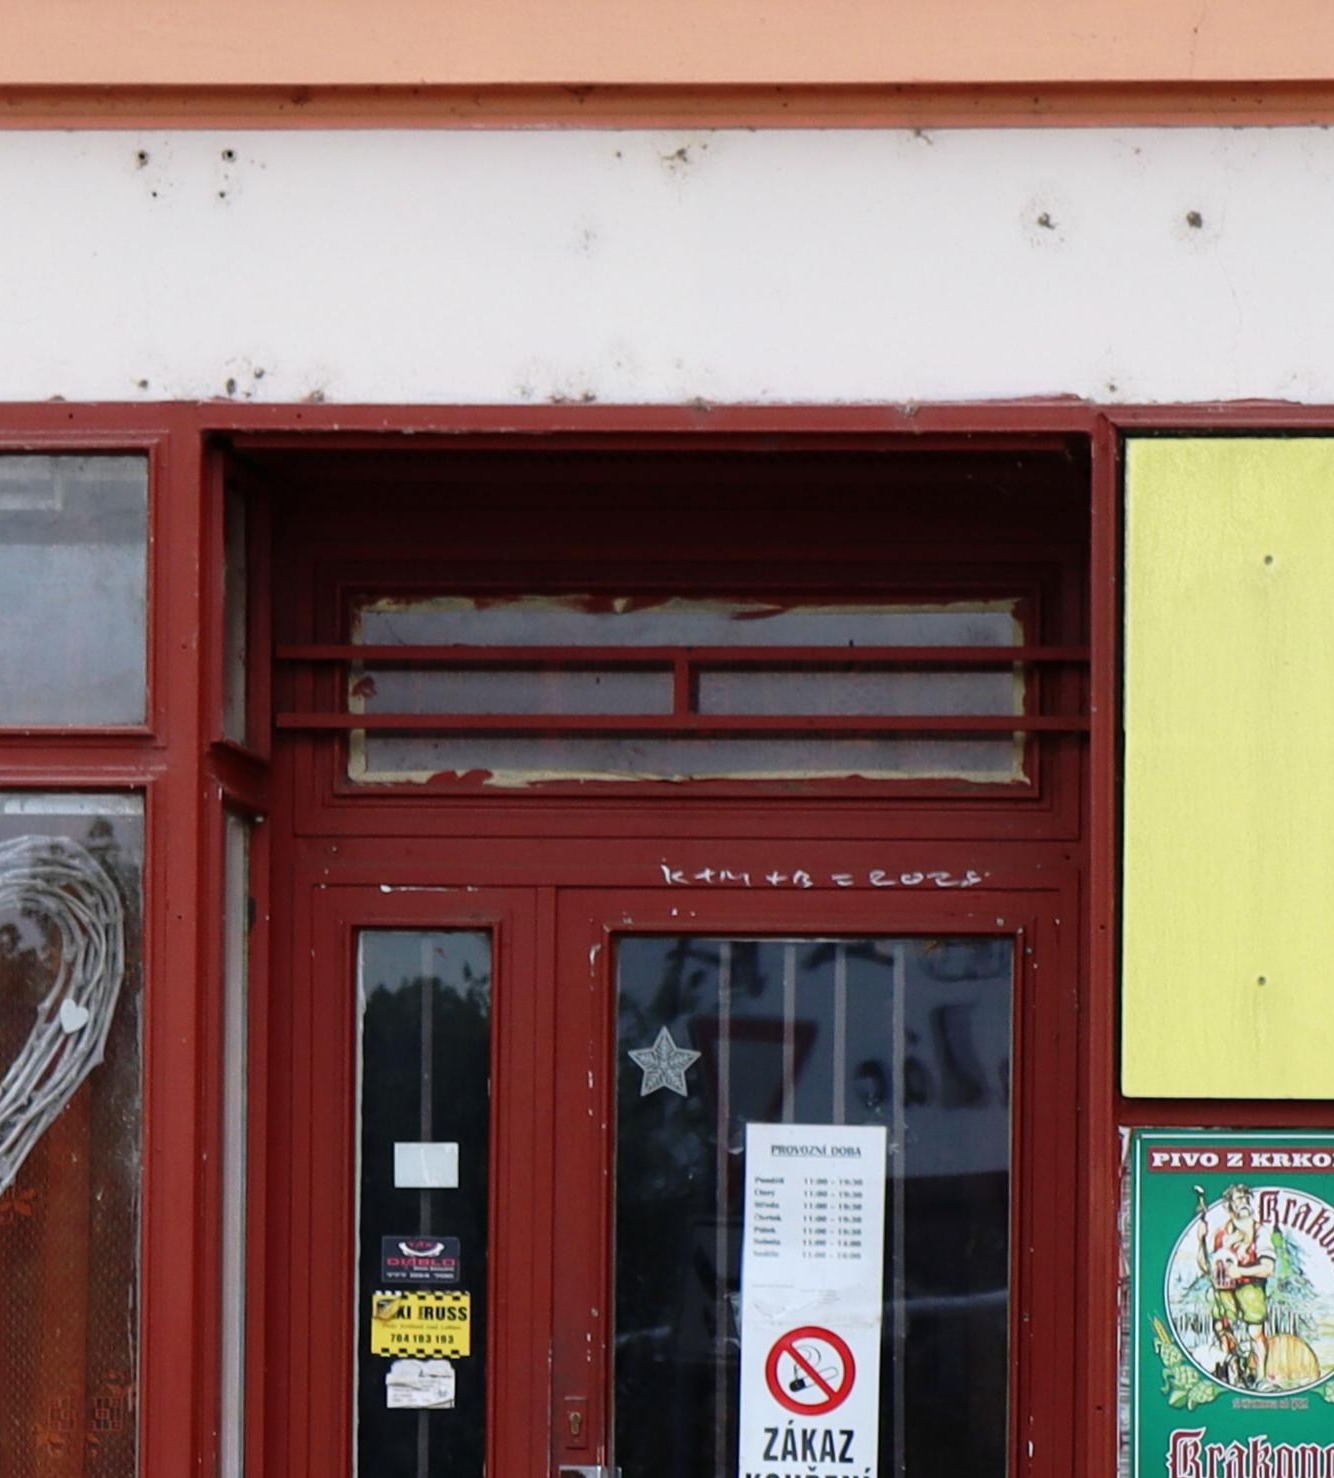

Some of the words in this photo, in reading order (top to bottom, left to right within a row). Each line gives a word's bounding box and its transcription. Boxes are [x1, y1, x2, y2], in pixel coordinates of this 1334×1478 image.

[1152, 1152, 1219, 1167] PIVO
[1226, 1152, 1244, 1167] Z
[763, 1419, 855, 1464] ZÁKAZ
